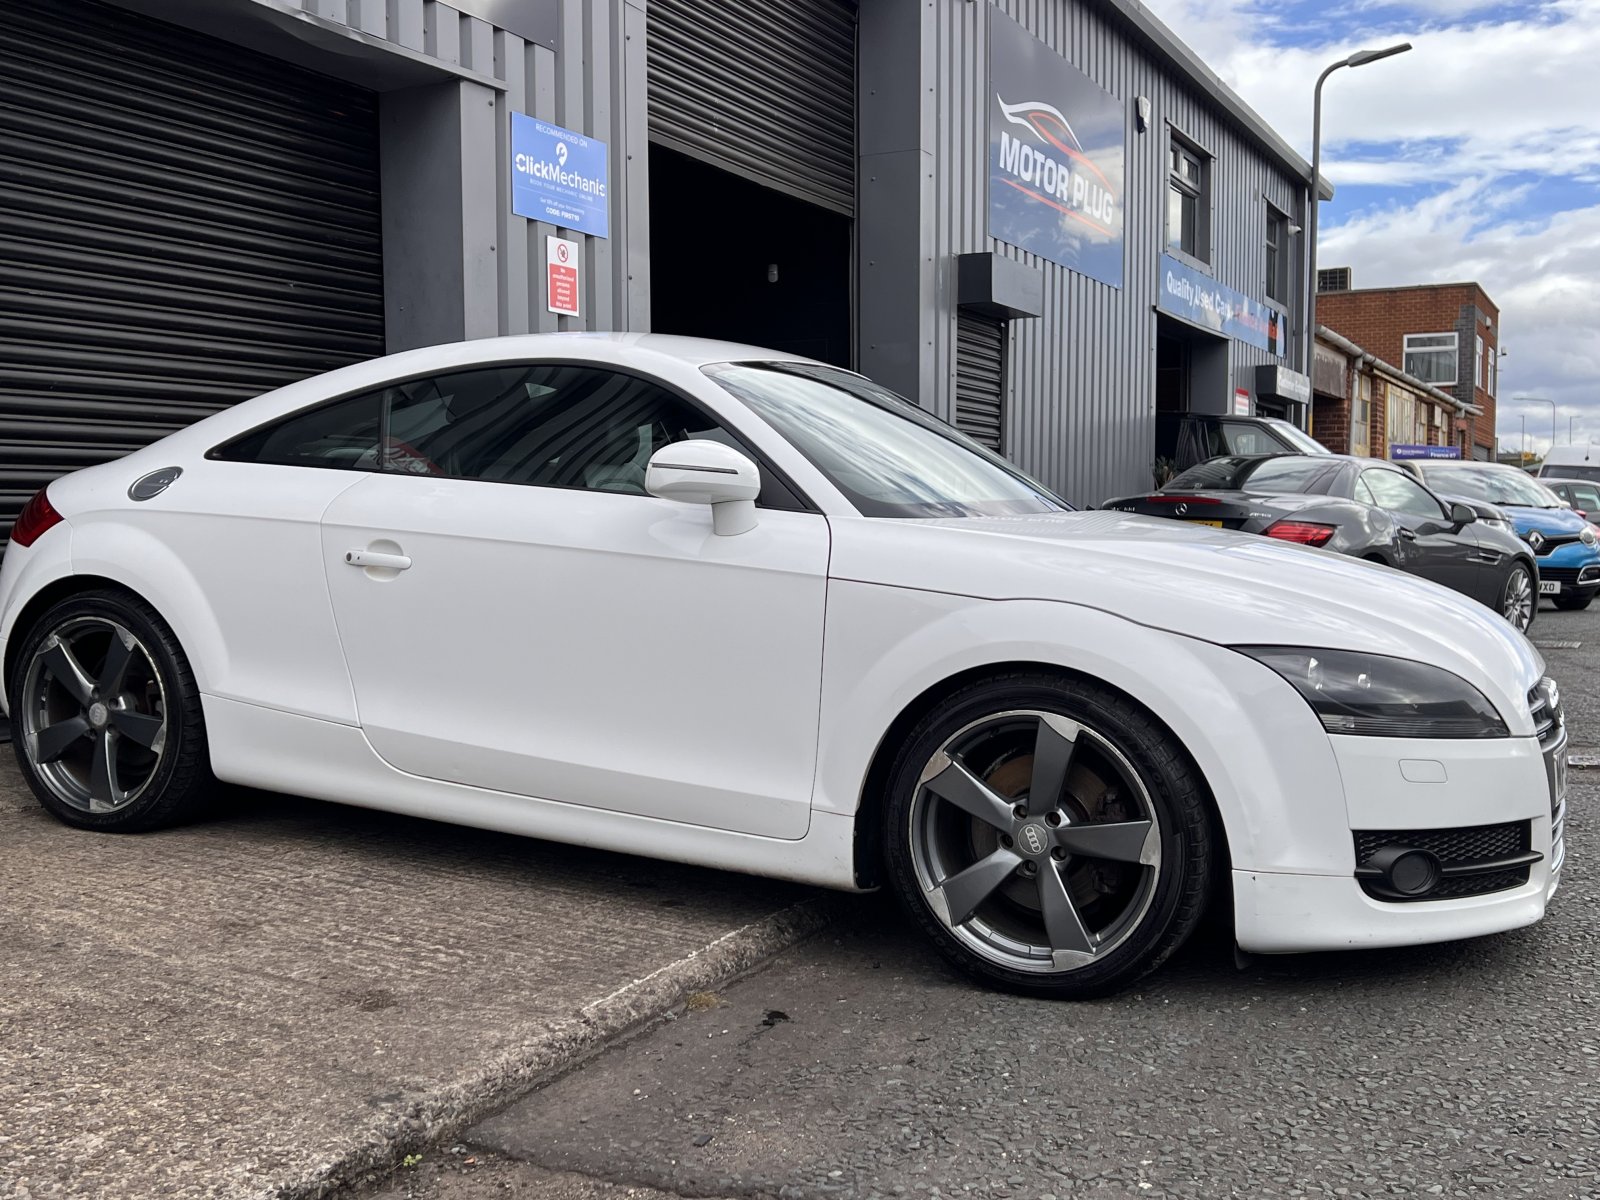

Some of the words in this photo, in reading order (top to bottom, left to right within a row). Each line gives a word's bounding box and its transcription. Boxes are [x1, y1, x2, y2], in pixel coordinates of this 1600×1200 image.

[535, 123, 578, 145] RECOMMENDED
[579, 137, 588, 148] ON
[999, 130, 1069, 202] MOTOR
[1072, 173, 1114, 225] PLUG
[1166, 269, 1194, 307] Quality
[1194, 284, 1214, 311] Used
